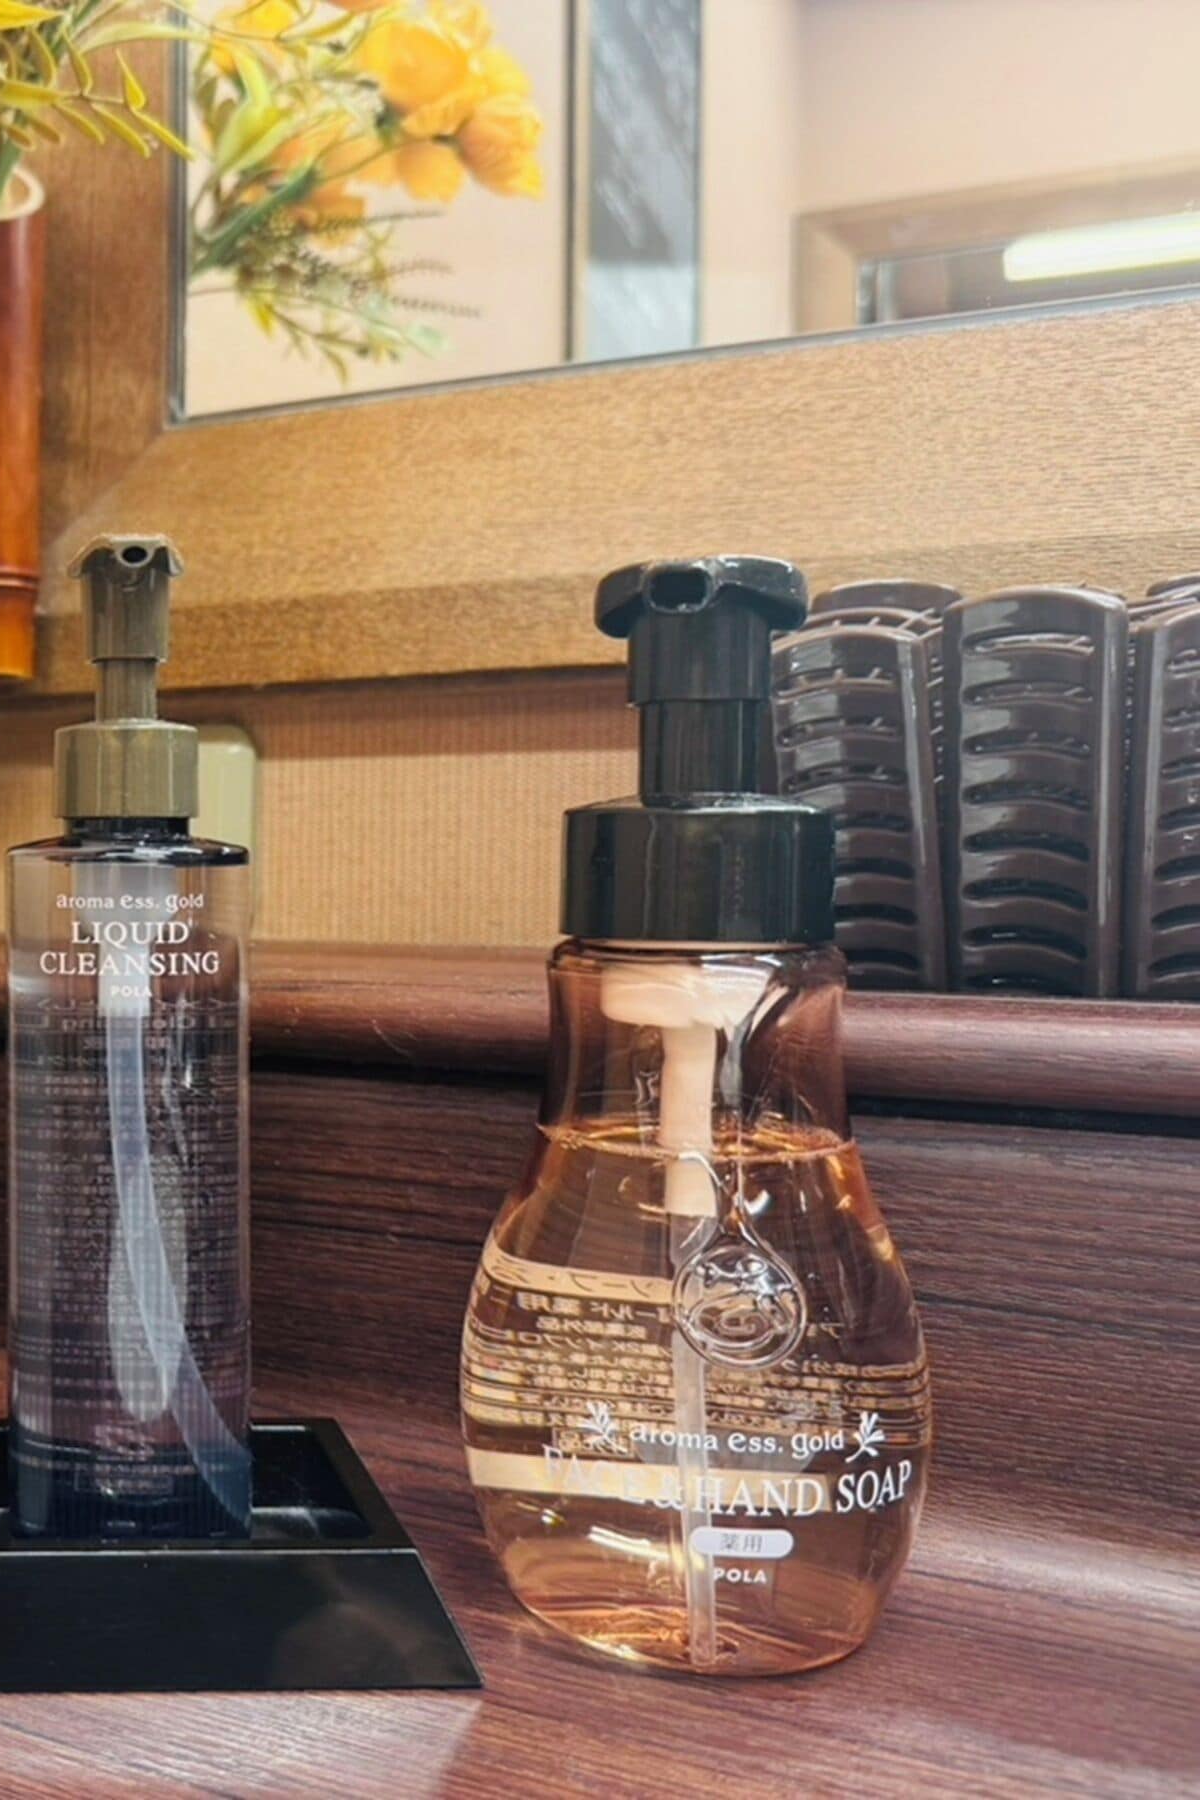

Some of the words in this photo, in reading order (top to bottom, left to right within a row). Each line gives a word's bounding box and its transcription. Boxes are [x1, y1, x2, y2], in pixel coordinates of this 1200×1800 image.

[56, 893, 115, 909] aroma
[120, 894, 160, 910] ess.
[166, 893, 204, 912] gold
[71, 921, 191, 949] LIQUID
[39, 951, 220, 976] CLEANSING
[110, 985, 152, 998] POLA
[628, 1423, 718, 1451] aroma
[727, 1431, 784, 1454] ess.
[791, 1430, 844, 1460] gold
[836, 1459, 912, 1512] SOAP
[712, 1567, 767, 1584] POLA
